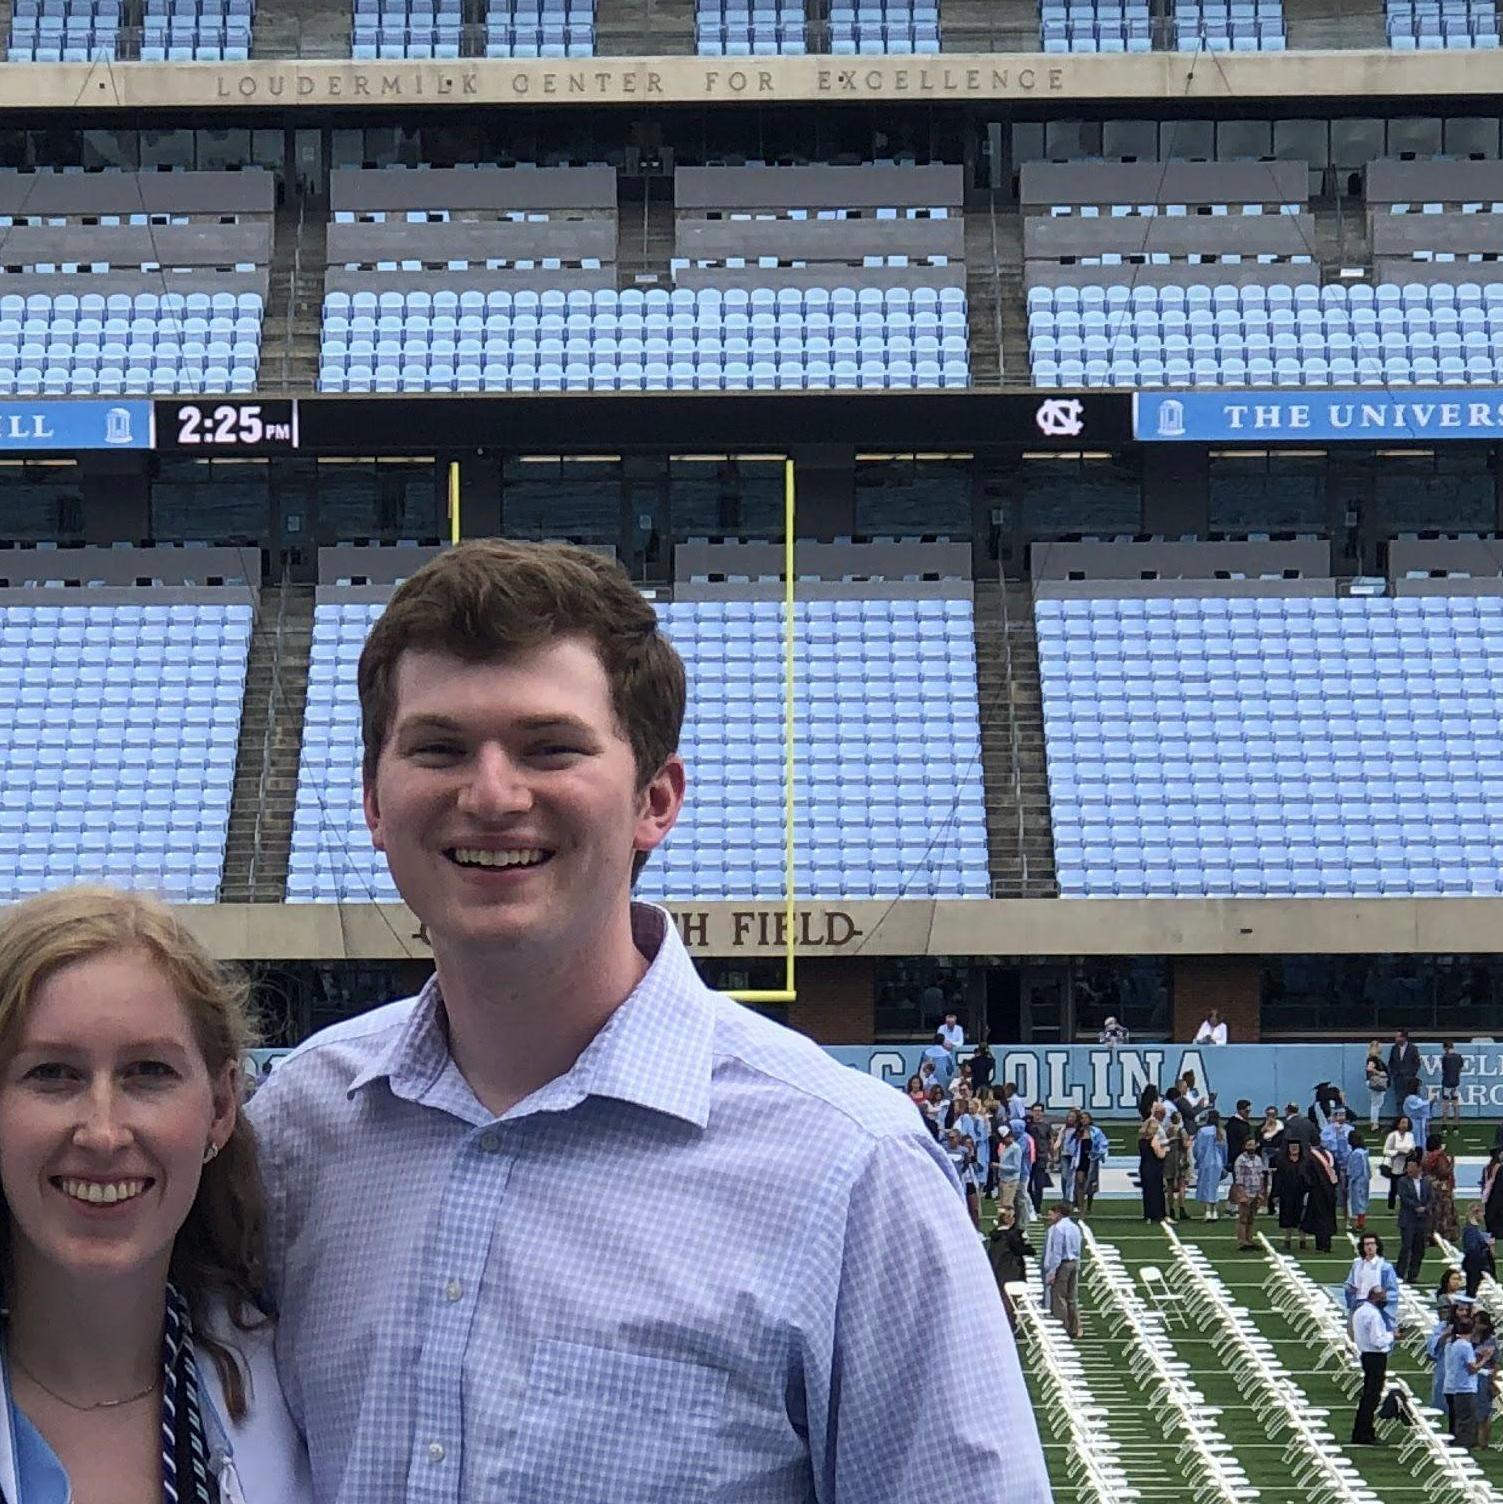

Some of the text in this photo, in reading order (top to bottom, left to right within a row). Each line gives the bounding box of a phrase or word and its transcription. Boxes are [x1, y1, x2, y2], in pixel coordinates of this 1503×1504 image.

[216, 69, 1064, 97] LOUDERMILK CENTER FOR EXCELLENCE
[1224, 405, 1310, 428] THE
[732, 911, 854, 946] FIELD
[869, 1049, 1215, 1110] COLINA
